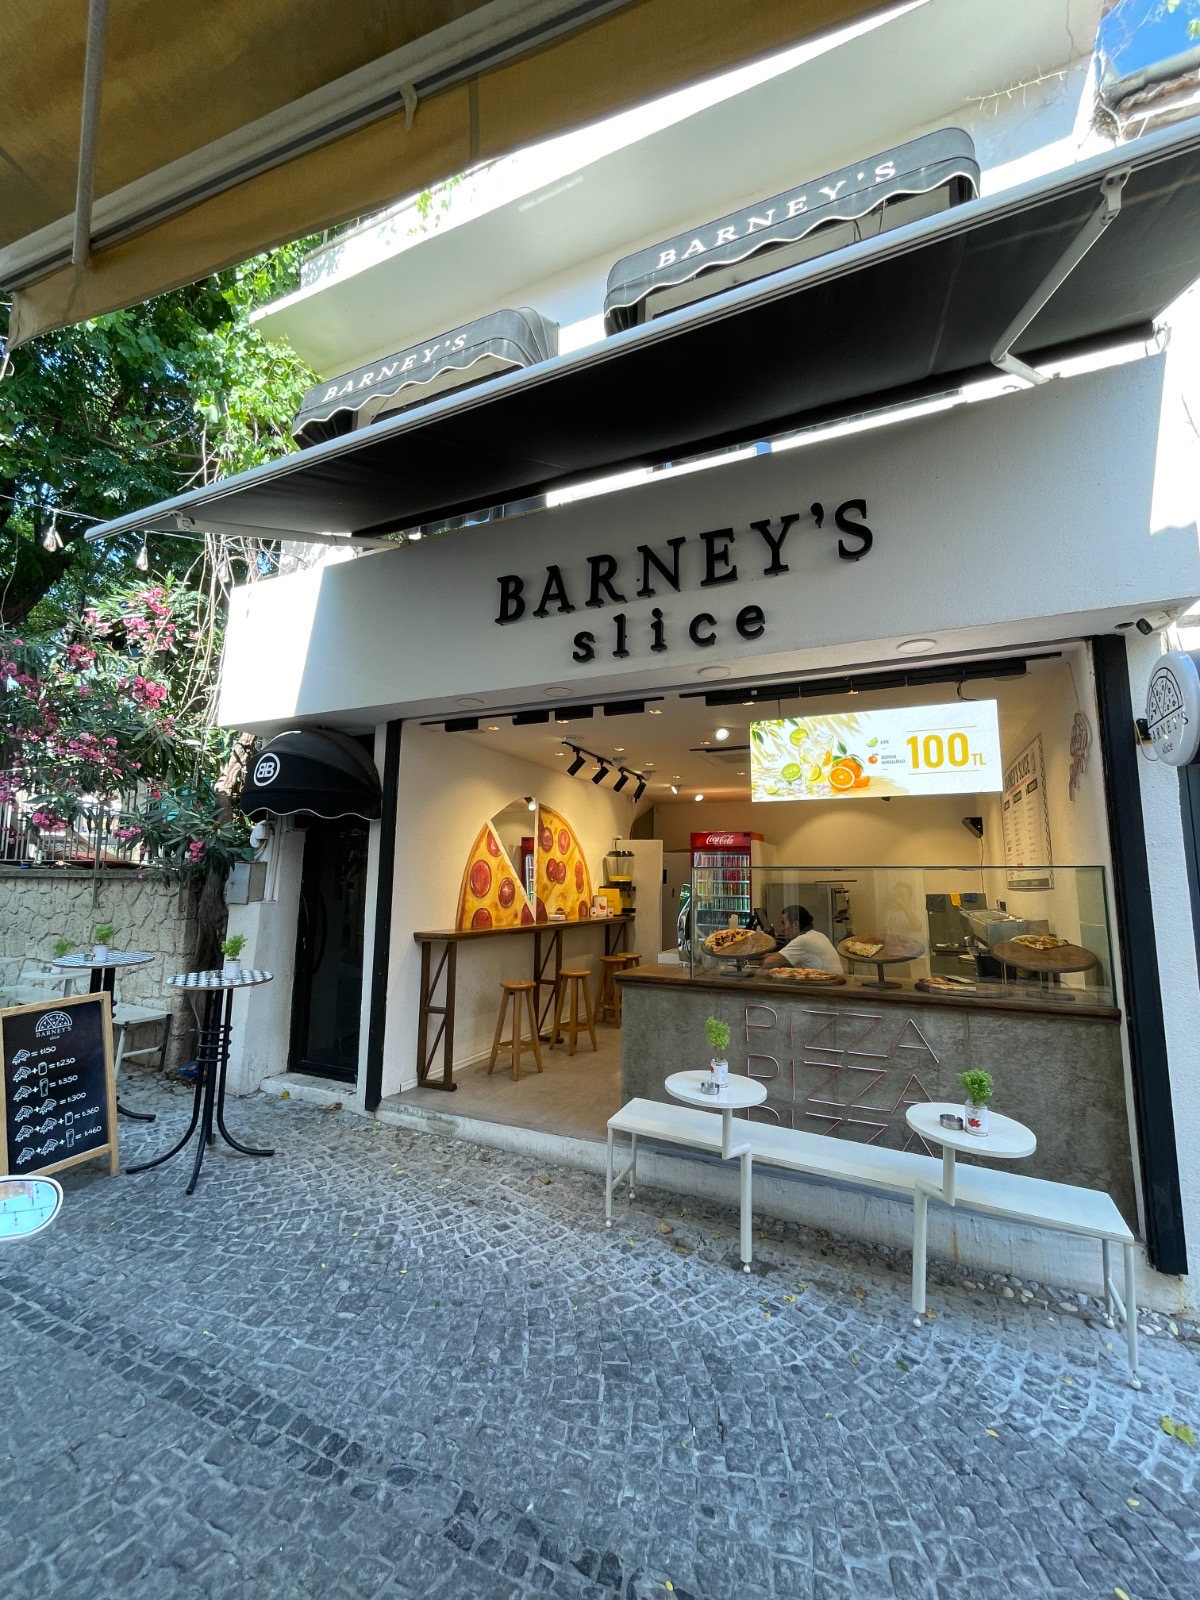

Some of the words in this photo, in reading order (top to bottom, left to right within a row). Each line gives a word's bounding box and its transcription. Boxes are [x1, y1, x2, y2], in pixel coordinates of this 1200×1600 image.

[656, 161, 896, 269] BARNEY'S
[321, 334, 467, 402] BARNEY'S
[495, 499, 873, 626] BARNEY'S
[572, 604, 766, 664] slice
[906, 732, 970, 769] 100
[971, 752, 987, 766] TL
[1151, 711, 1189, 743] ARNEY'S
[36, 1025, 72, 1038] BARNEY'S
[745, 1005, 940, 1063] PIZZA
[748, 1054, 933, 1114] PIZZA
